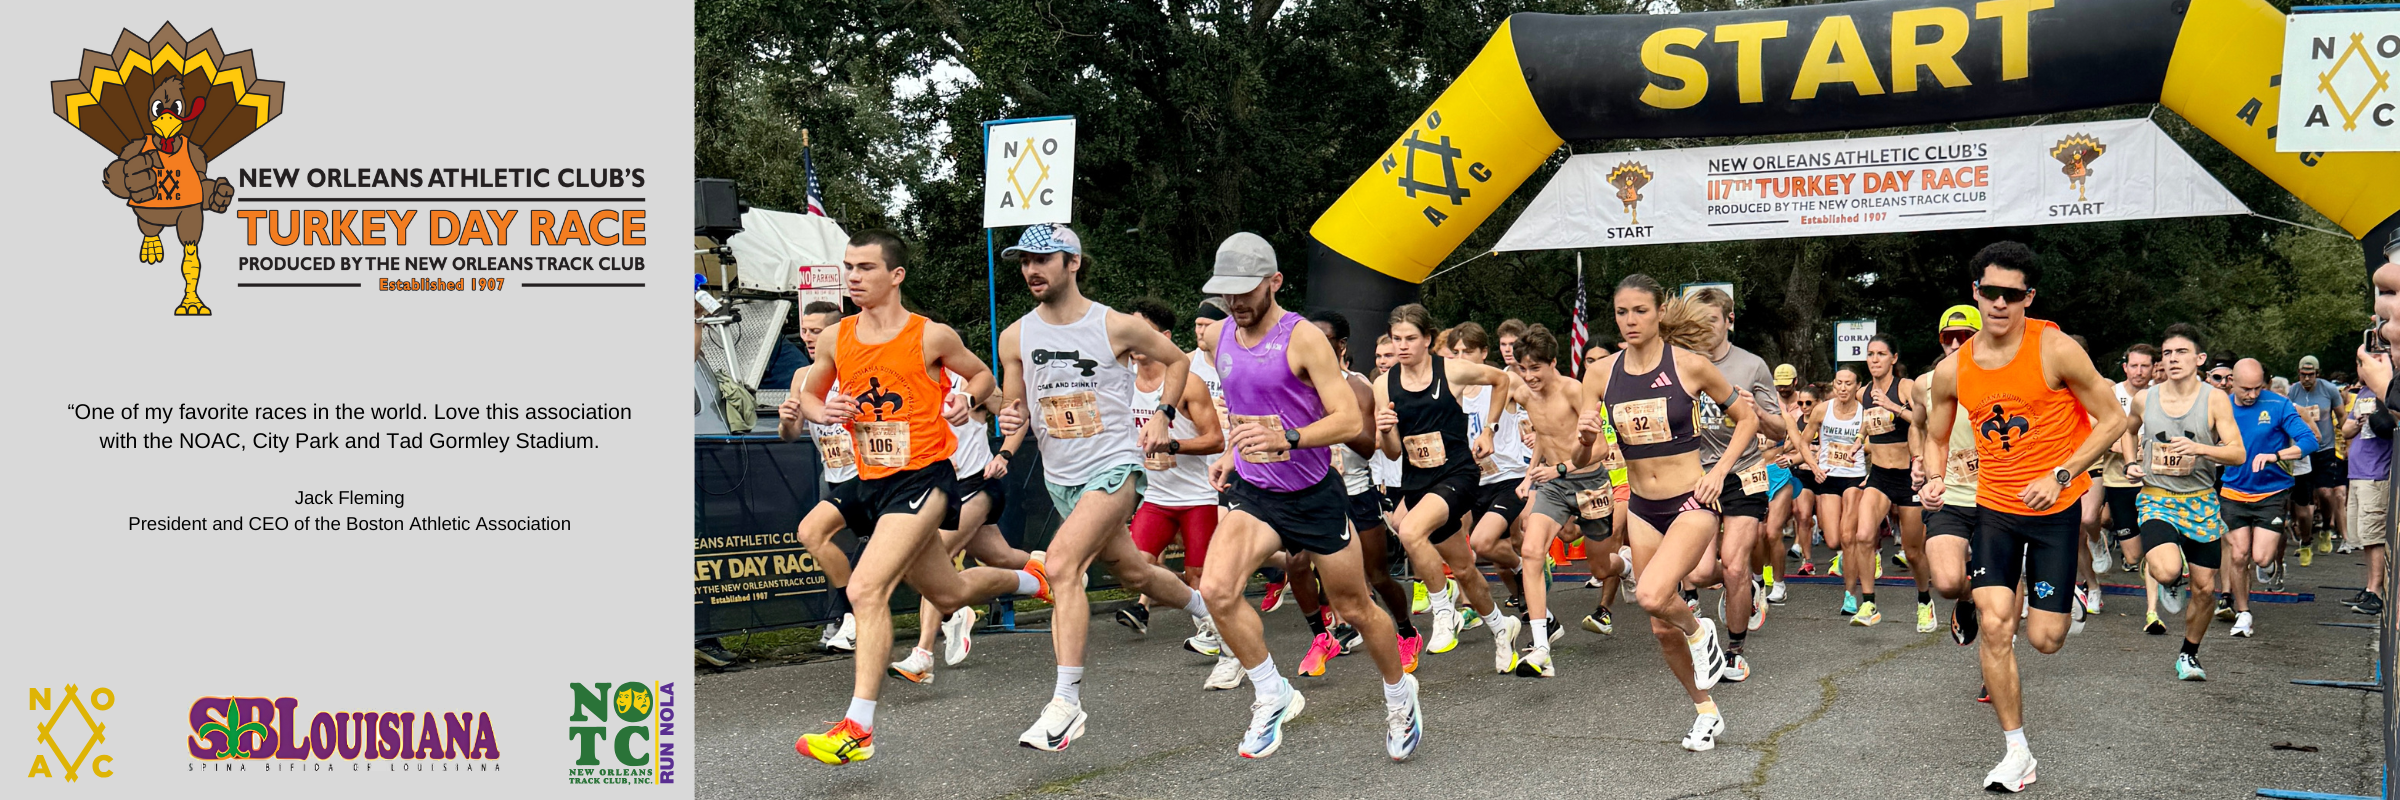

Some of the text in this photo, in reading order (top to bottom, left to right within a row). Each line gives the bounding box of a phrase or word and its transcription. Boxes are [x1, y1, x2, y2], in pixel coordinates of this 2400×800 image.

[1639, 0, 2055, 110] START
[1708, 143, 1987, 172] NEW ORLEANS ATHLETIC CLUB’S
[1755, 173, 1856, 199] TURKEY
[1863, 170, 1915, 194] DAY
[1922, 165, 1989, 190] RACE
[1708, 191, 1986, 215] PRODUCED BY THE NEW ORLEANS TRACK CLUB
[2049, 202, 2104, 217] START
[1801, 212, 1887, 225] Established 1907
[1607, 226, 1653, 239] START
[1852, 346, 1861, 356] B
[1065, 411, 1075, 425] 9
[1633, 416, 1650, 431] 32
[1872, 417, 1882, 426] 76
[827, 446, 841, 458] 148
[870, 438, 893, 453] 106
[1417, 446, 1430, 458] 28
[1833, 451, 1848, 460] 530
[2163, 455, 2183, 466] 187
[1751, 471, 1767, 483] 578
[1591, 496, 1609, 509] 100
[725, 532, 781, 548] ATHLETIC
[728, 555, 769, 579] DAY
[702, 585, 720, 594] THE
[721, 583, 741, 593] NEW
[742, 580, 779, 591] ORLEANS
[779, 578, 805, 588] TRACK
[805, 575, 826, 585] CLUB
[710, 592, 768, 605] Established 1907
